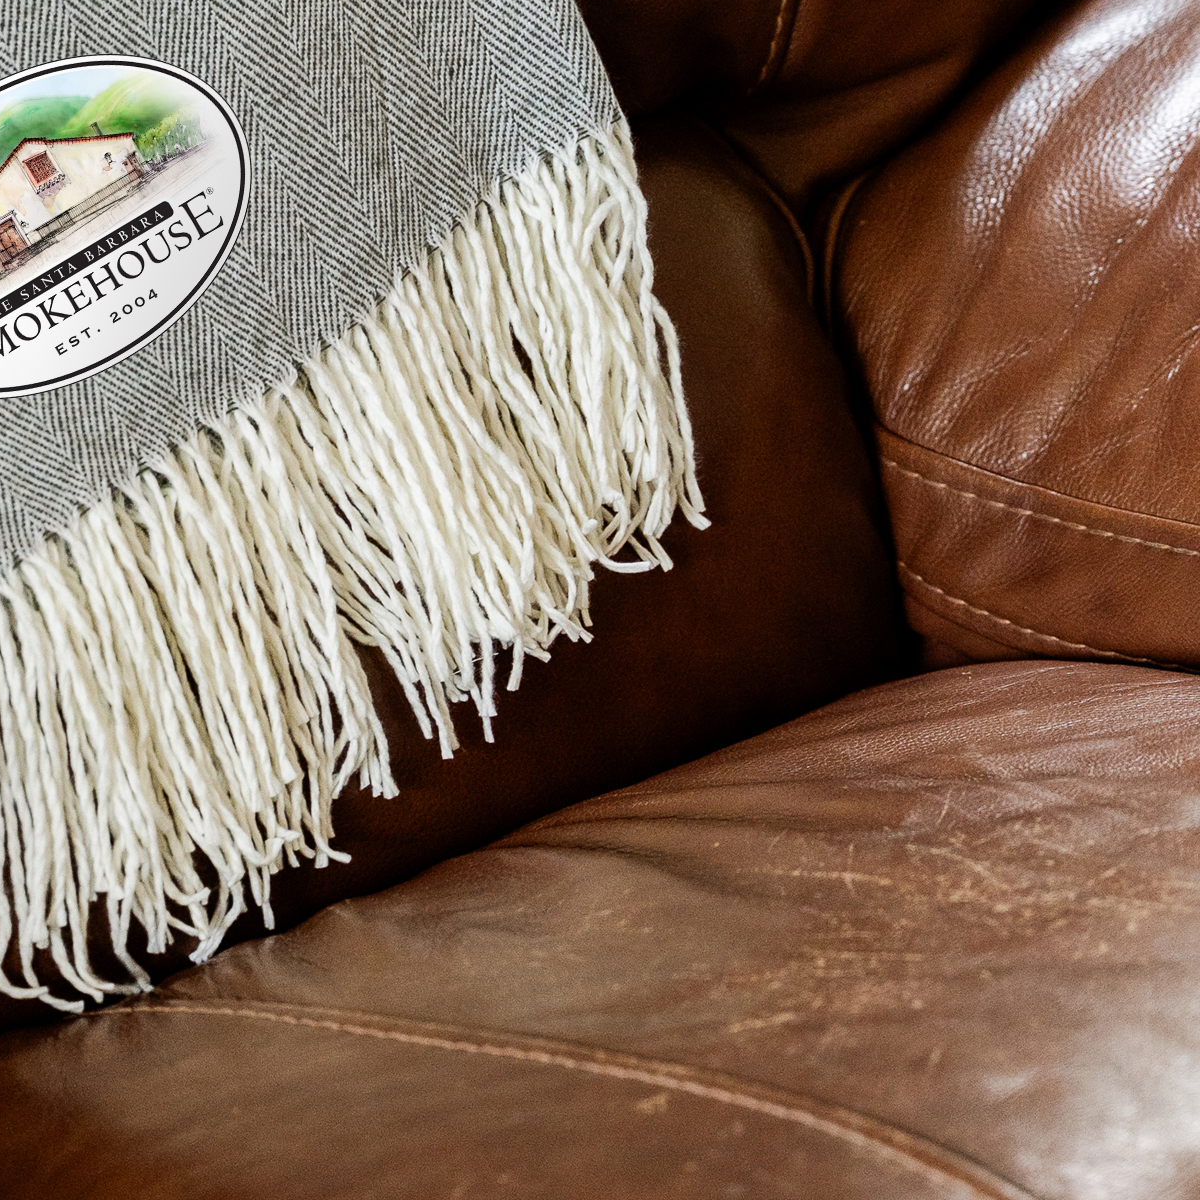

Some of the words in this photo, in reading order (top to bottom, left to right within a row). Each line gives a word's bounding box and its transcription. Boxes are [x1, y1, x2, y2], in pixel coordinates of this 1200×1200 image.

[19, 263, 78, 300] SANTA
[84, 210, 164, 262] BARBARA
[54, 327, 101, 356] EST.
[109, 288, 158, 323] 2004
